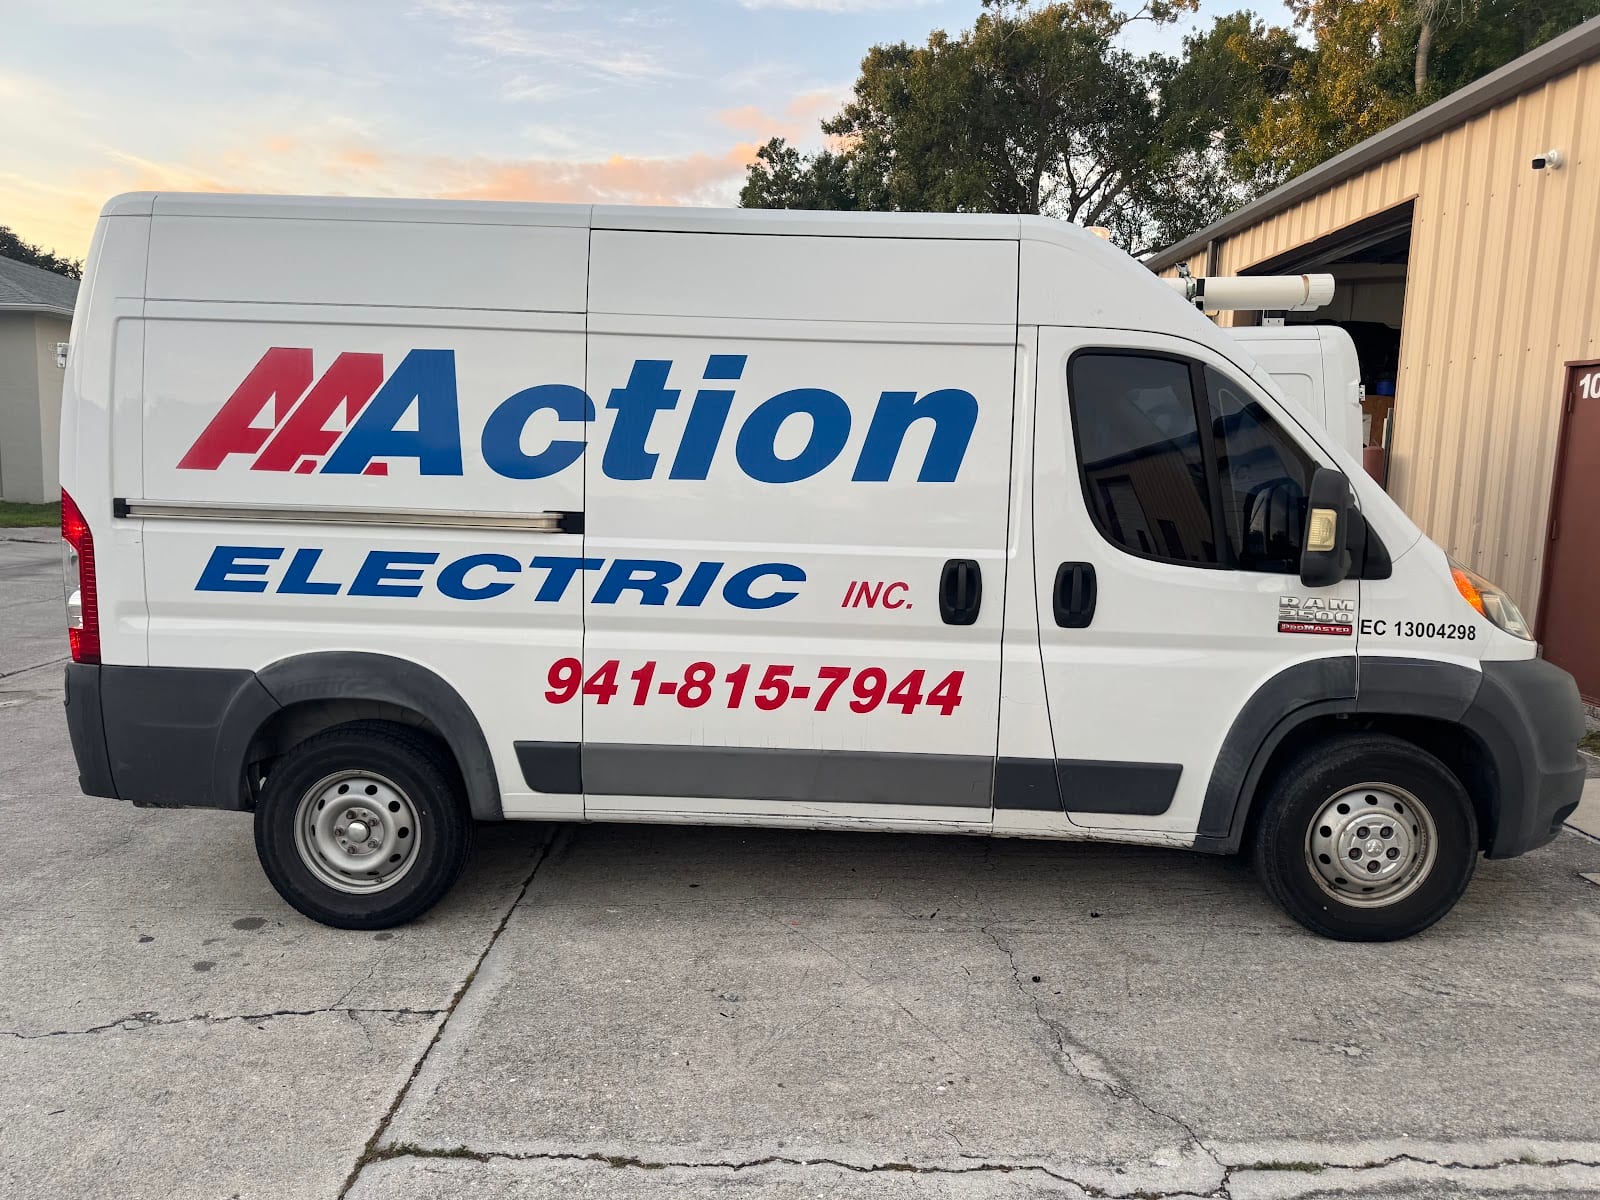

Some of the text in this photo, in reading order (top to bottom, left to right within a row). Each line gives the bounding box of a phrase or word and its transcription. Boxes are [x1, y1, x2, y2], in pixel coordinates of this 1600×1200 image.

[194, 545, 913, 610] ELECTRIC INC.
[1279, 595, 1355, 611] RAM
[1278, 608, 1354, 623] 2500
[1360, 619, 1476, 641] EC 13004298
[544, 657, 965, 717] 941-815-7944
